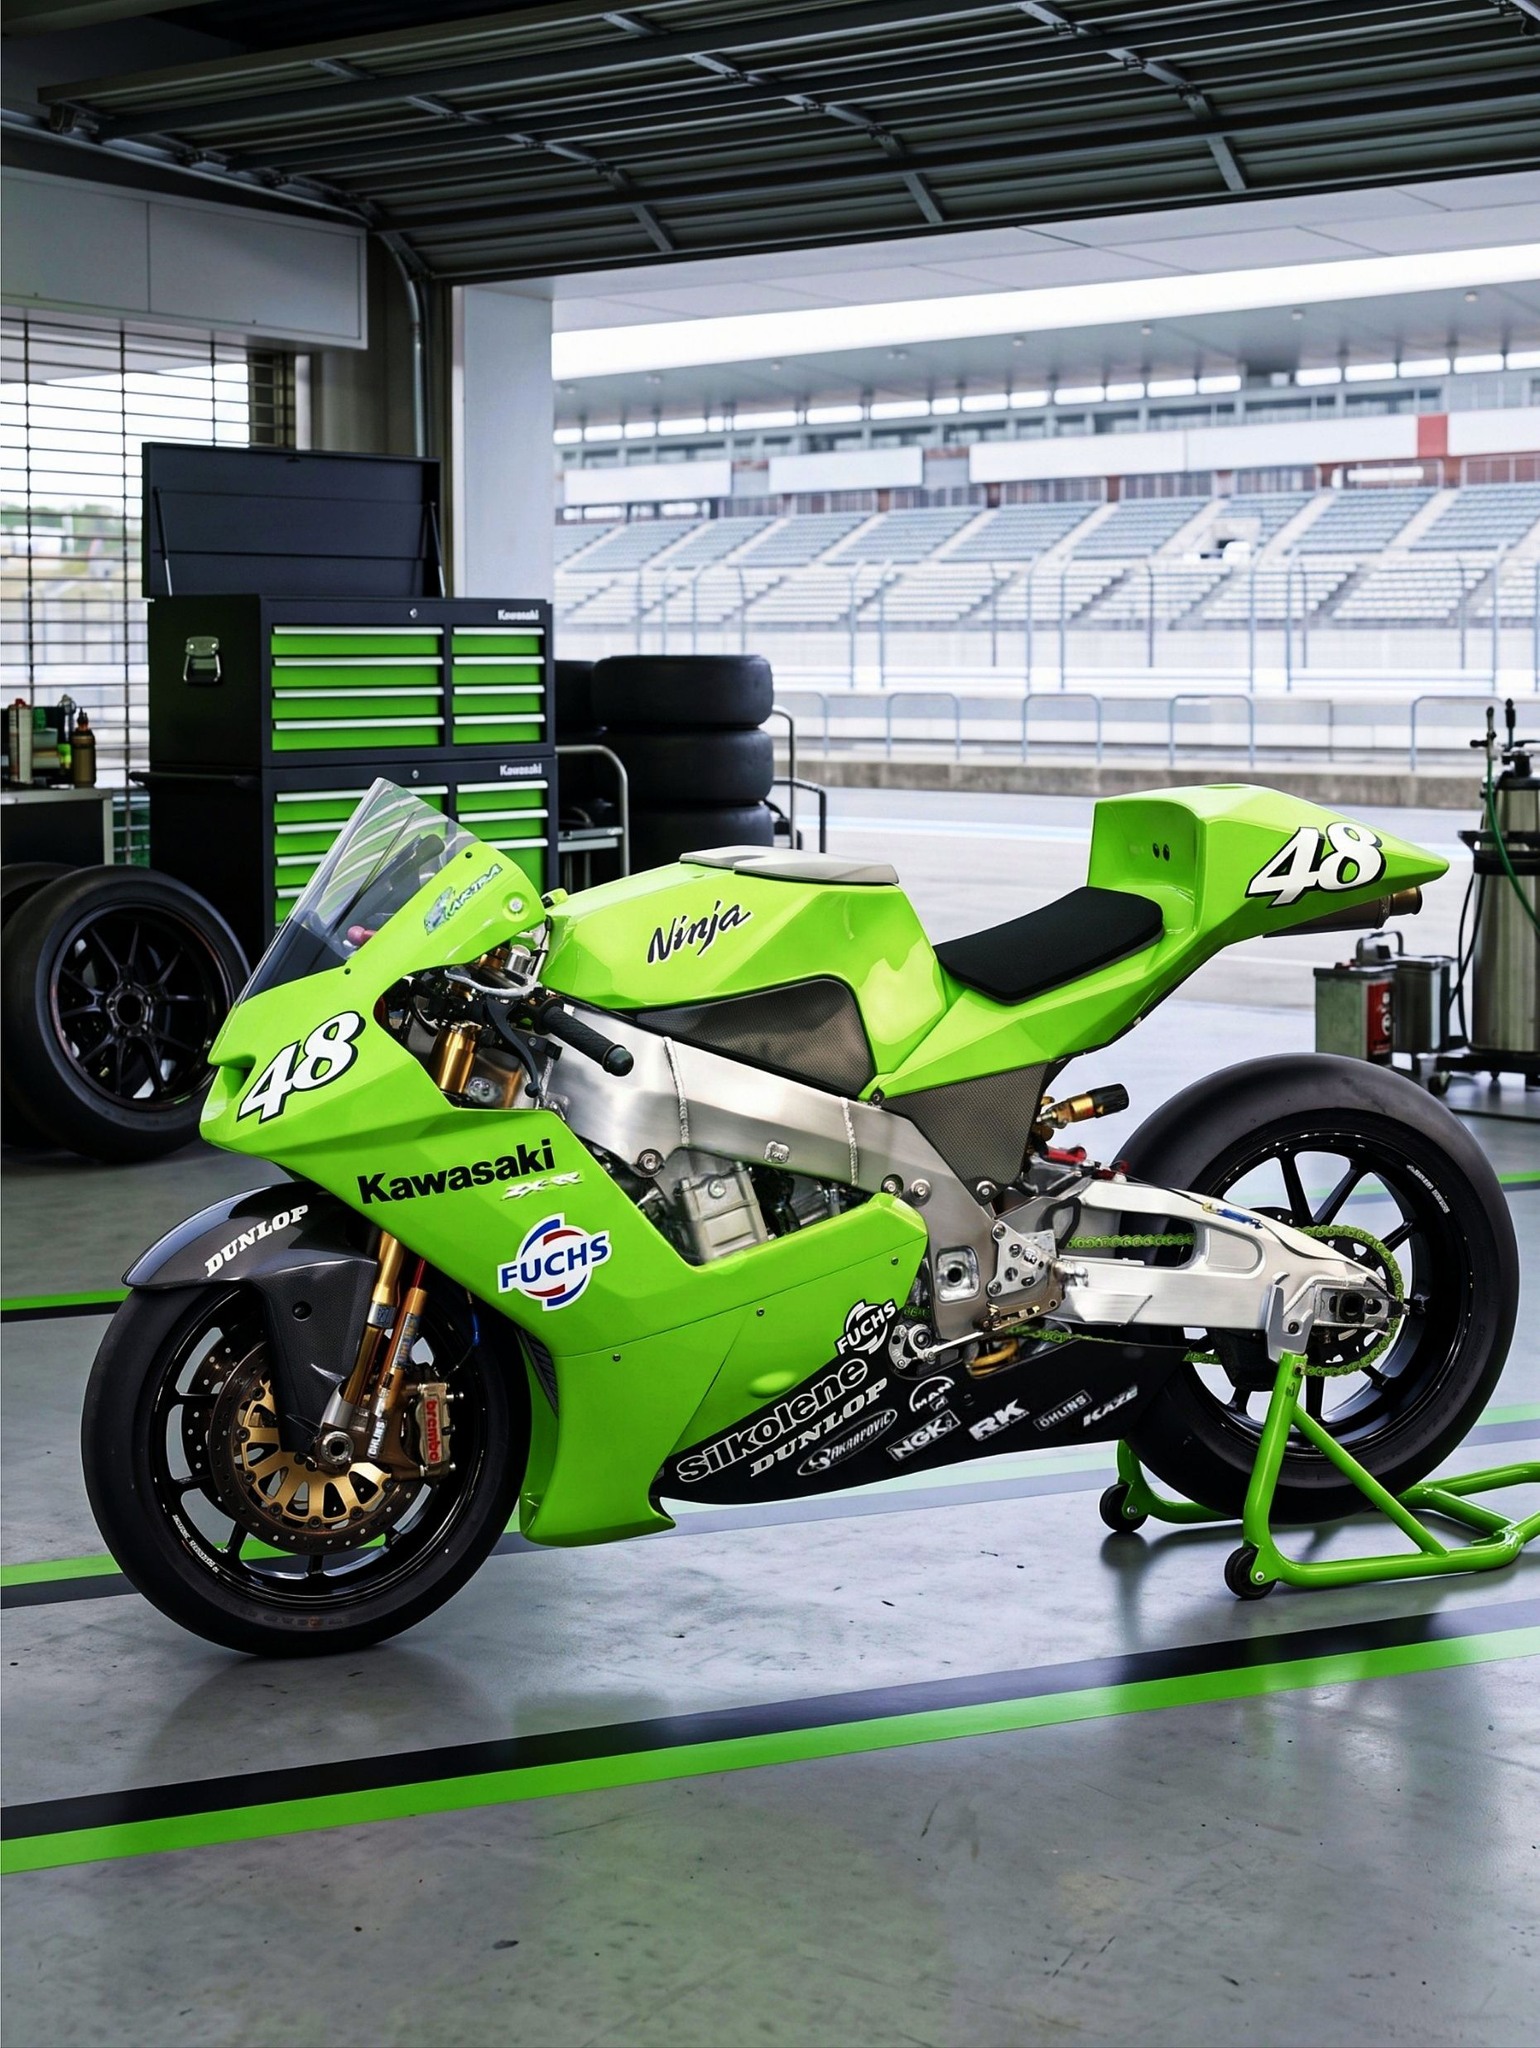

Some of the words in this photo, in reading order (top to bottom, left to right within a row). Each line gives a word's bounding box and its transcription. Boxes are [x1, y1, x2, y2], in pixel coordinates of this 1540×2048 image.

[499, 762, 542, 777] Kawasaki
[1245, 822, 1387, 908] 48
[647, 899, 752, 965] Ninja
[236, 1010, 367, 1125] 48
[356, 1137, 556, 1205] Kawasaki
[204, 1204, 309, 1278] DUNLOP
[501, 1235, 609, 1290] FUCHS
[836, 1300, 896, 1355] FUCHS
[750, 1376, 887, 1478] DUNLOP
[892, 1419, 948, 1460] NGK
[968, 1398, 1027, 1438] RK
